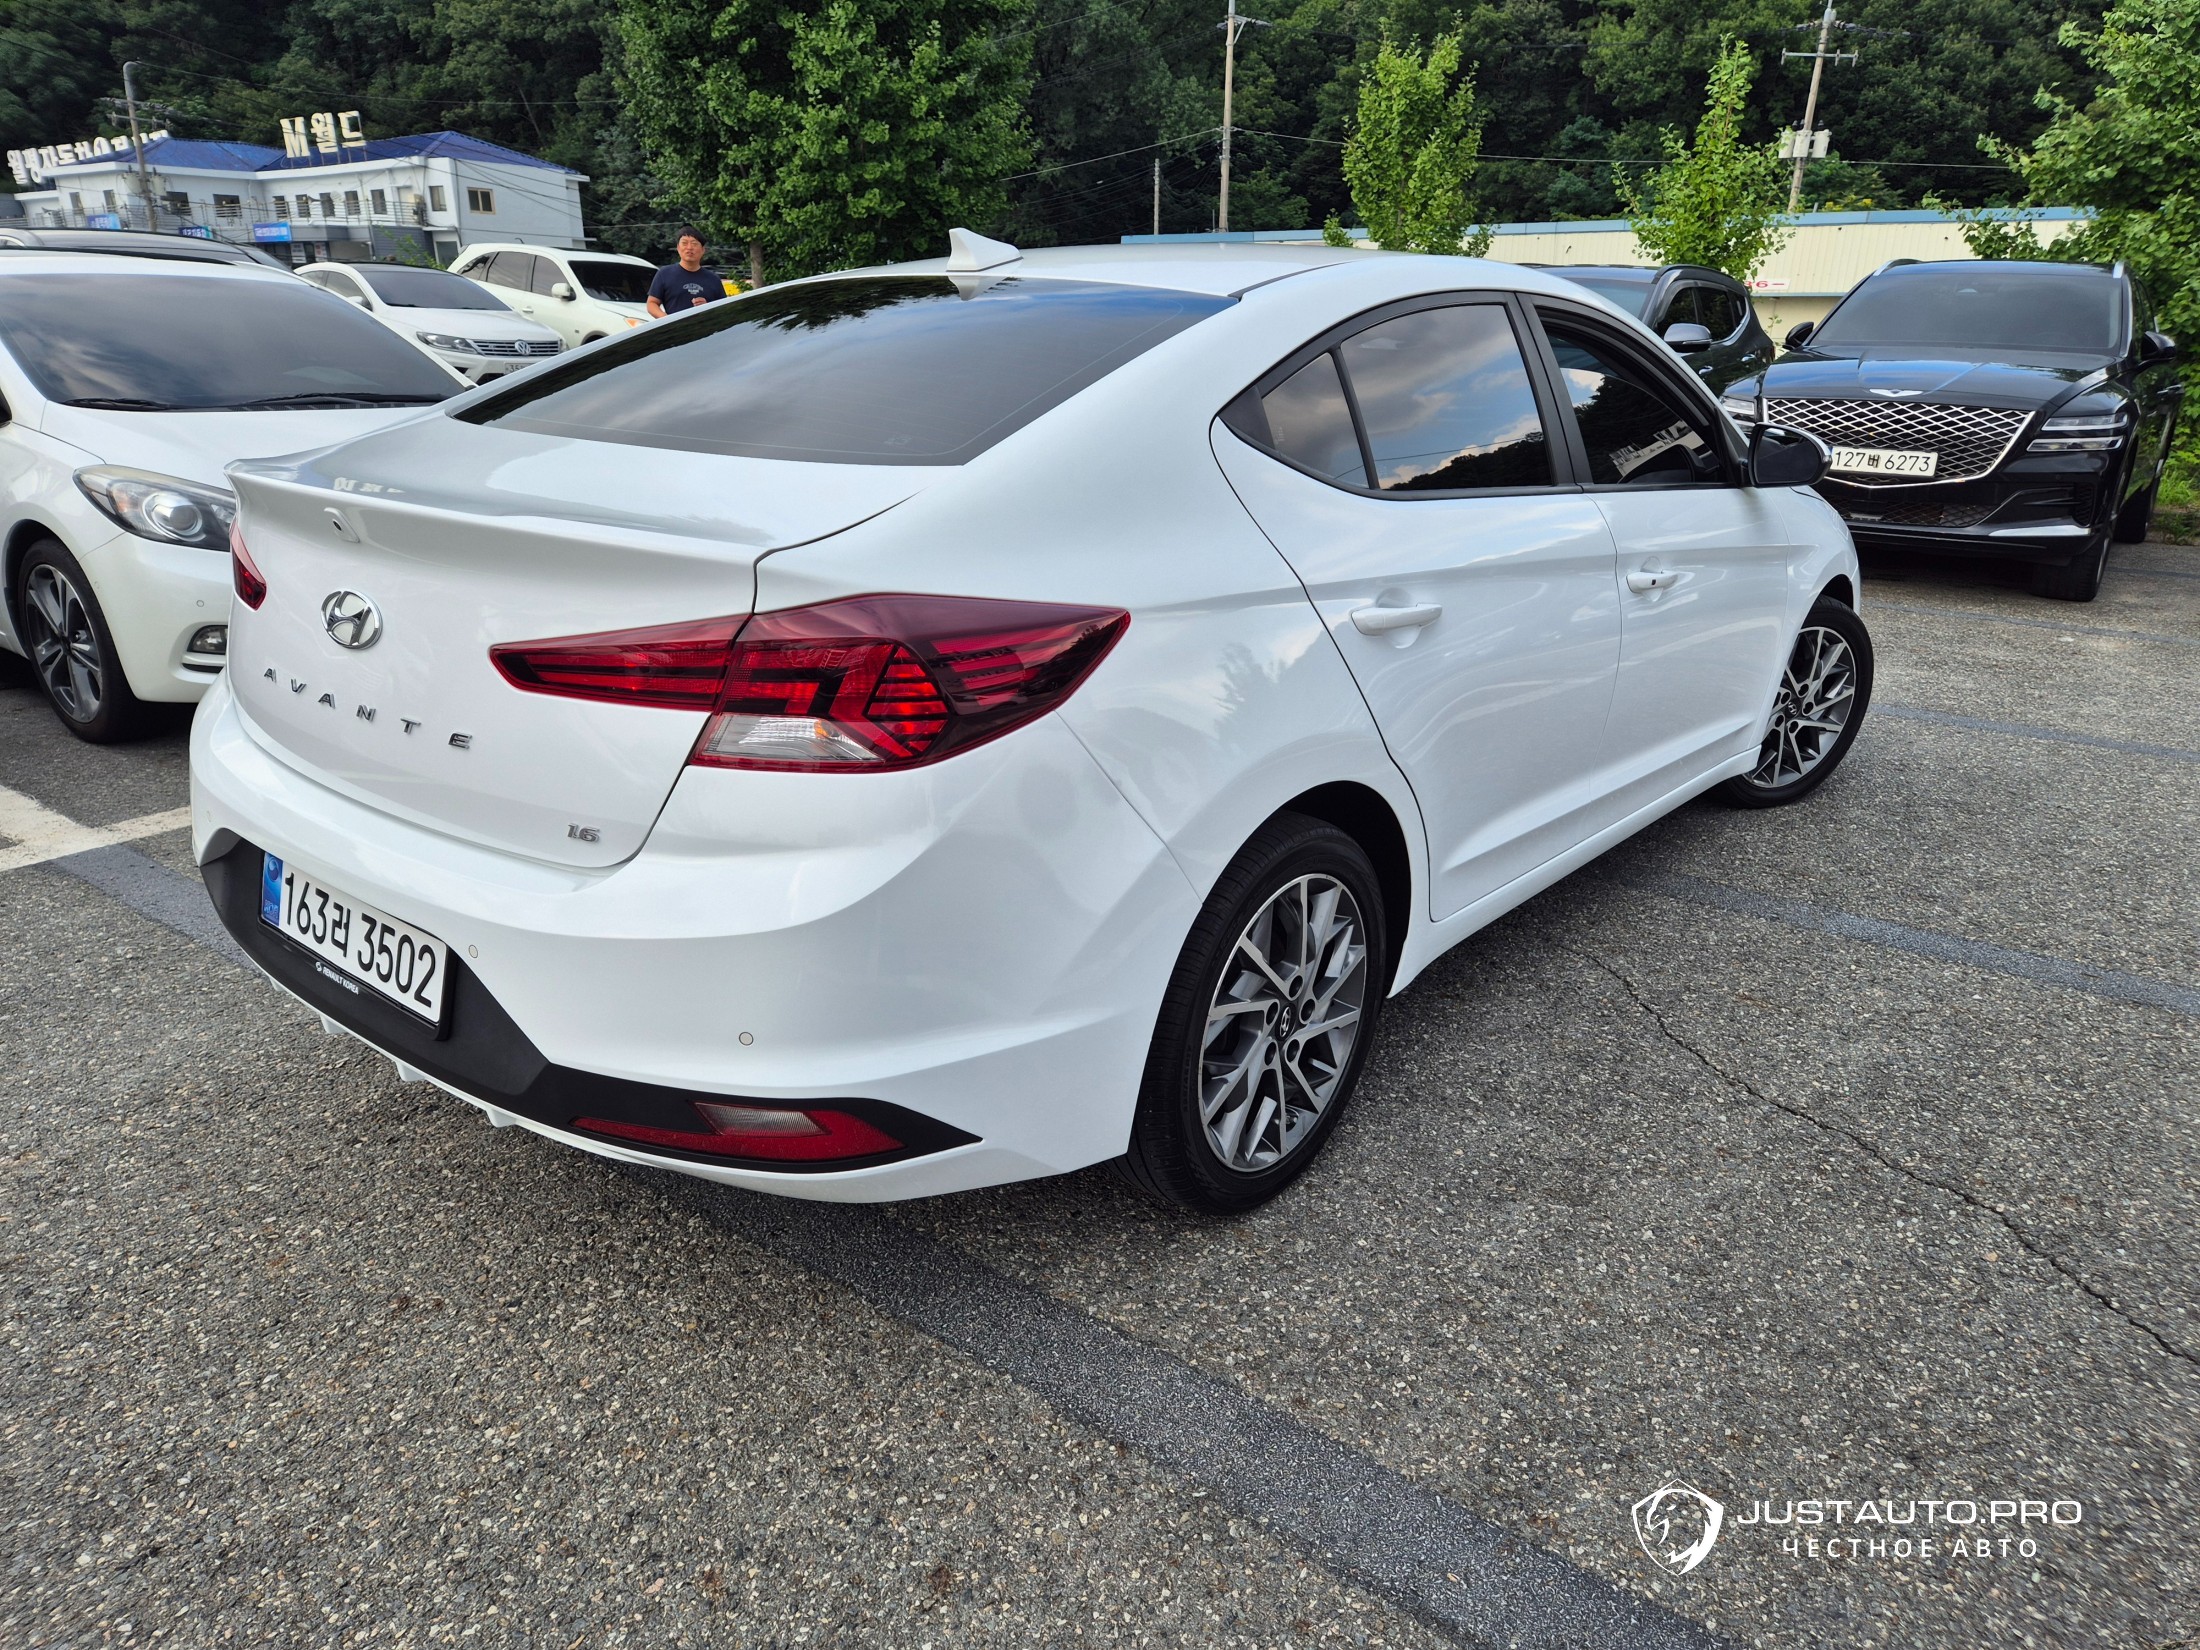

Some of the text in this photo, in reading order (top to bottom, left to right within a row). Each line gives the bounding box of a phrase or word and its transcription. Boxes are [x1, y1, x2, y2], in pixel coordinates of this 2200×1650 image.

[1835, 451, 1931, 472] 127버 6273
[264, 668, 473, 750] AVANTE
[285, 872, 436, 1008] 163러 3502
[322, 966, 359, 995] RENAULT KOREA
